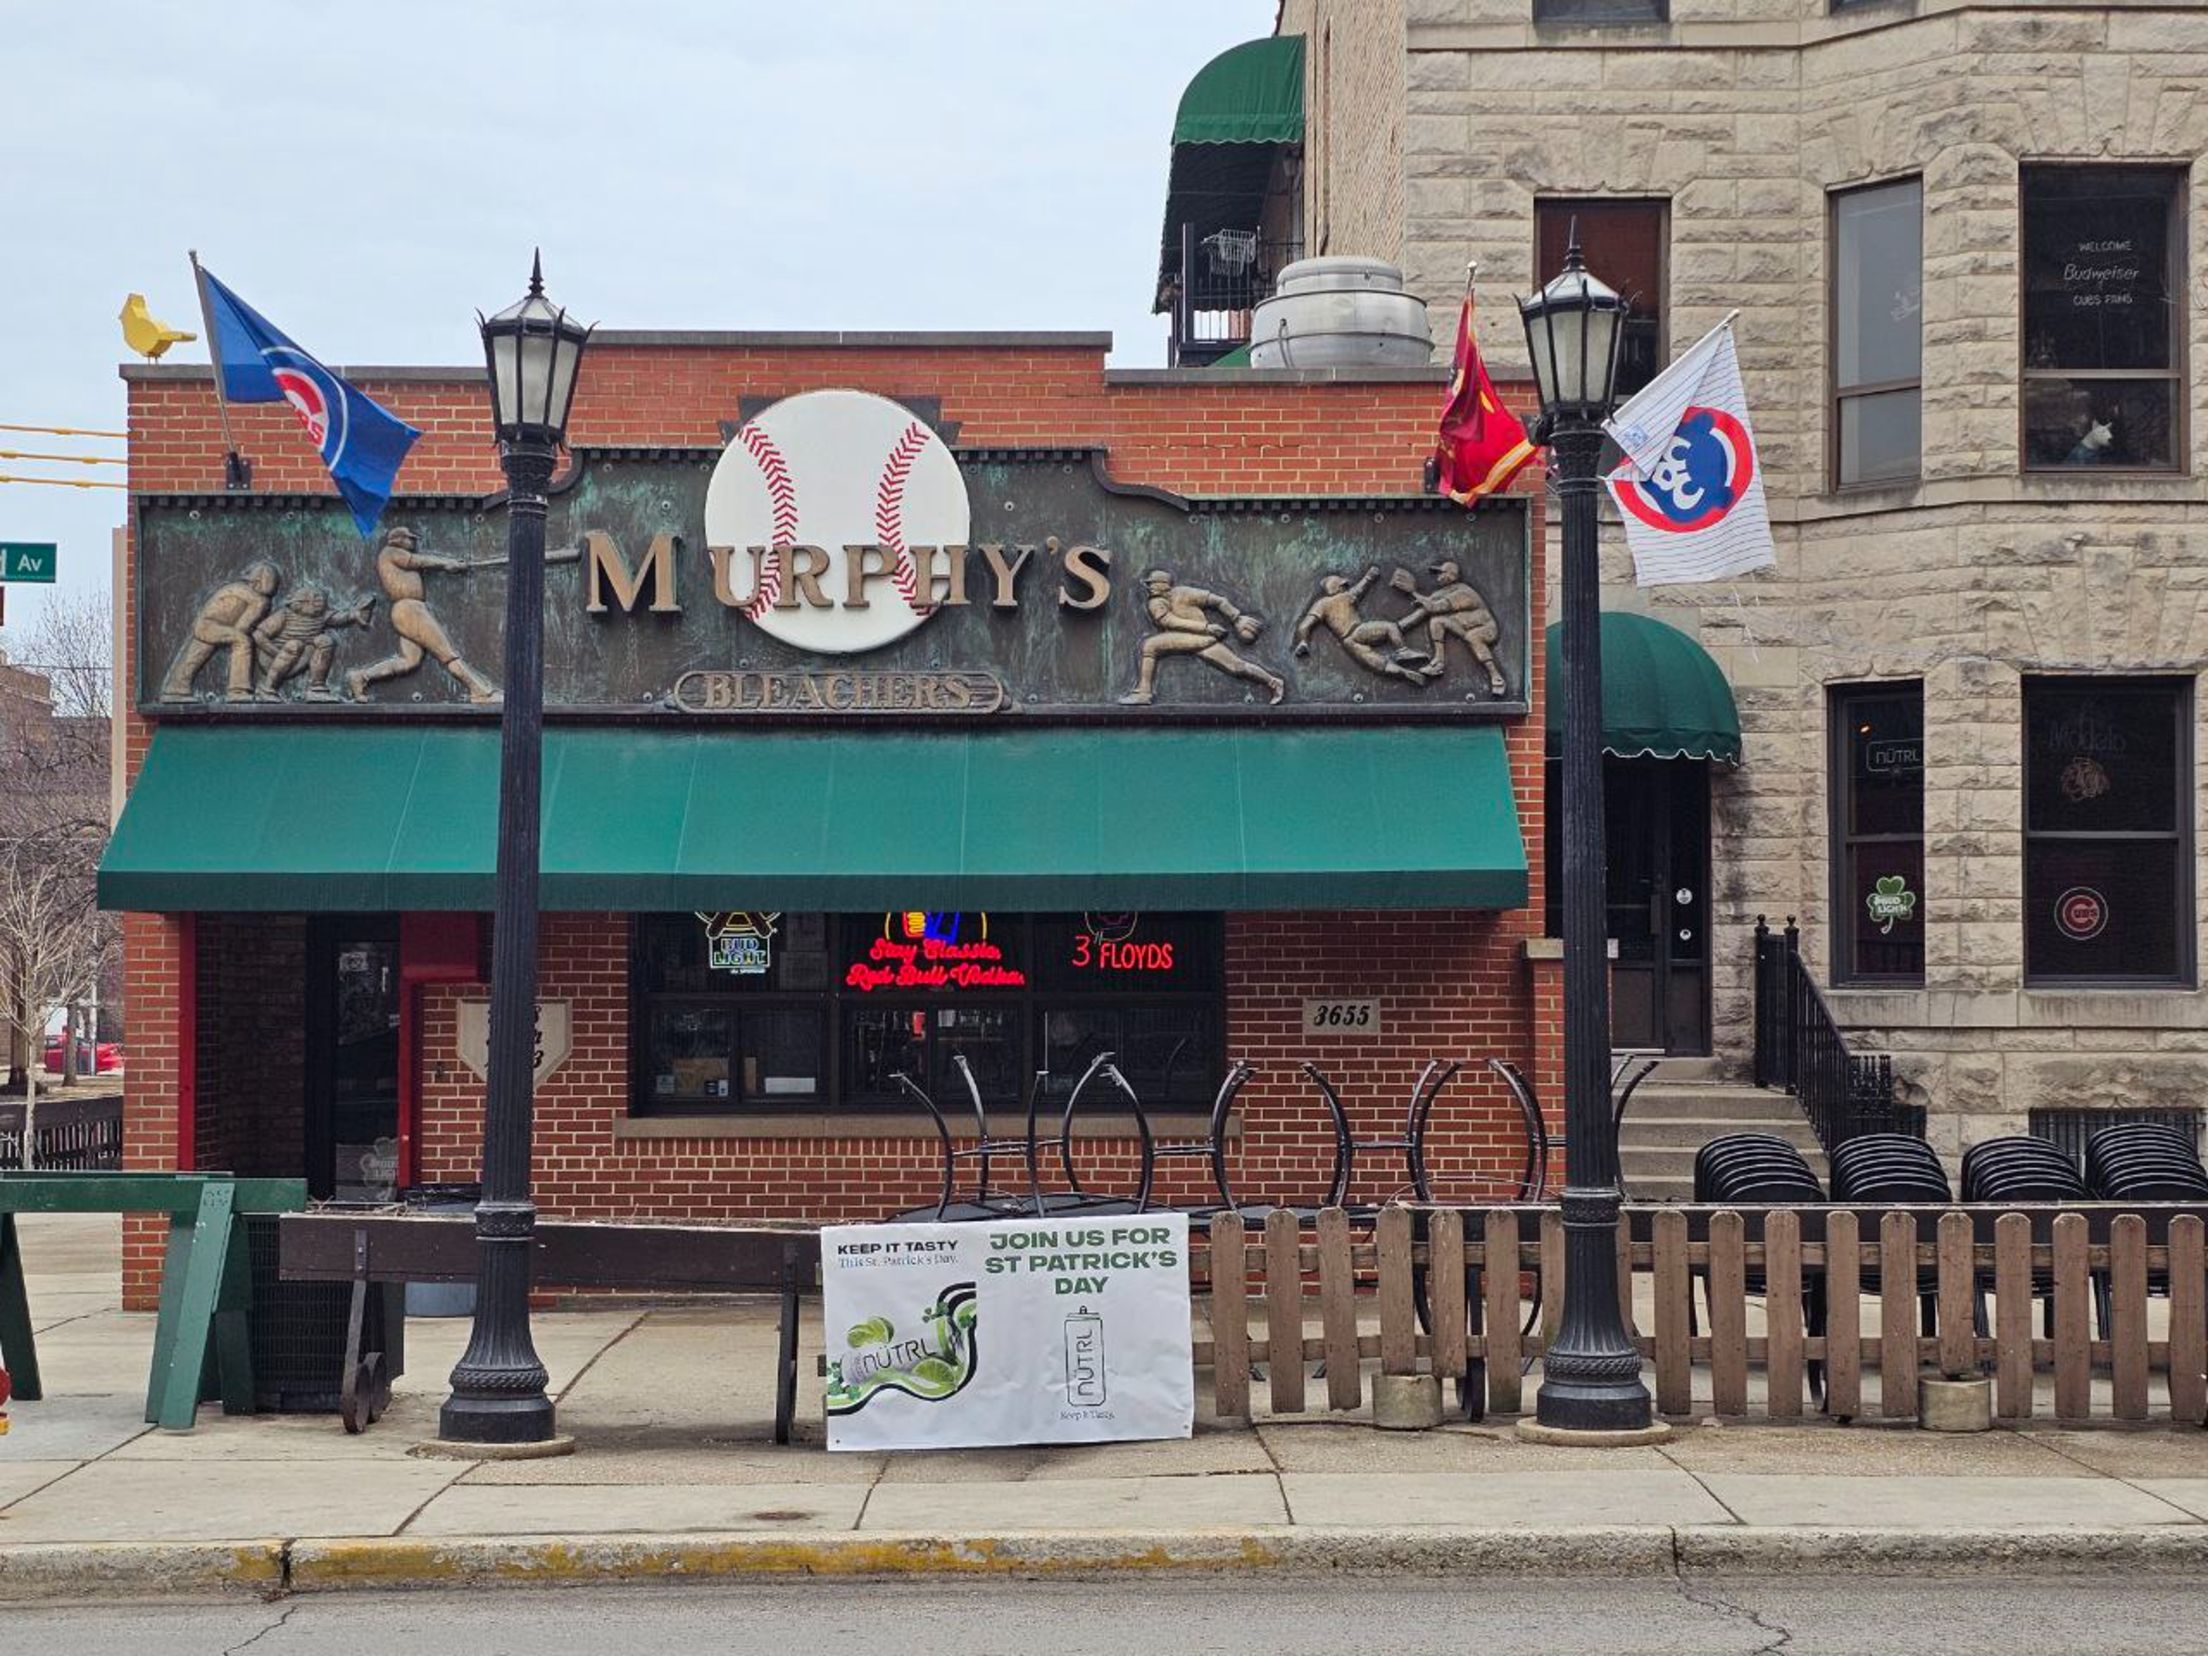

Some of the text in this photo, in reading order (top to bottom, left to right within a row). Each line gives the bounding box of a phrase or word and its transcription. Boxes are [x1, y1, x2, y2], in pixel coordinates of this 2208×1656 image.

[2078, 240, 2133, 252] WELCOME
[2064, 263, 2140, 281] Budweiser
[17, 553, 43, 572] Av
[584, 529, 1113, 614] MURPHY'S
[703, 673, 973, 709] BLEACHERS
[720, 937, 760, 951] BUD
[869, 937, 918, 966] Stay
[1072, 935, 1173, 969] 3 FLOYDS
[713, 950, 767, 965] LIGHT
[846, 963, 895, 992] Red
[896, 964, 949, 987] Bull
[1313, 1004, 1370, 1026] 3655
[837, 1239, 958, 1255] KEEP IT TASTY
[990, 1227, 1171, 1250] JOIN US FOR
[985, 1249, 1177, 1274] ST PATRICK'S
[1055, 1275, 1110, 1295] DAY
